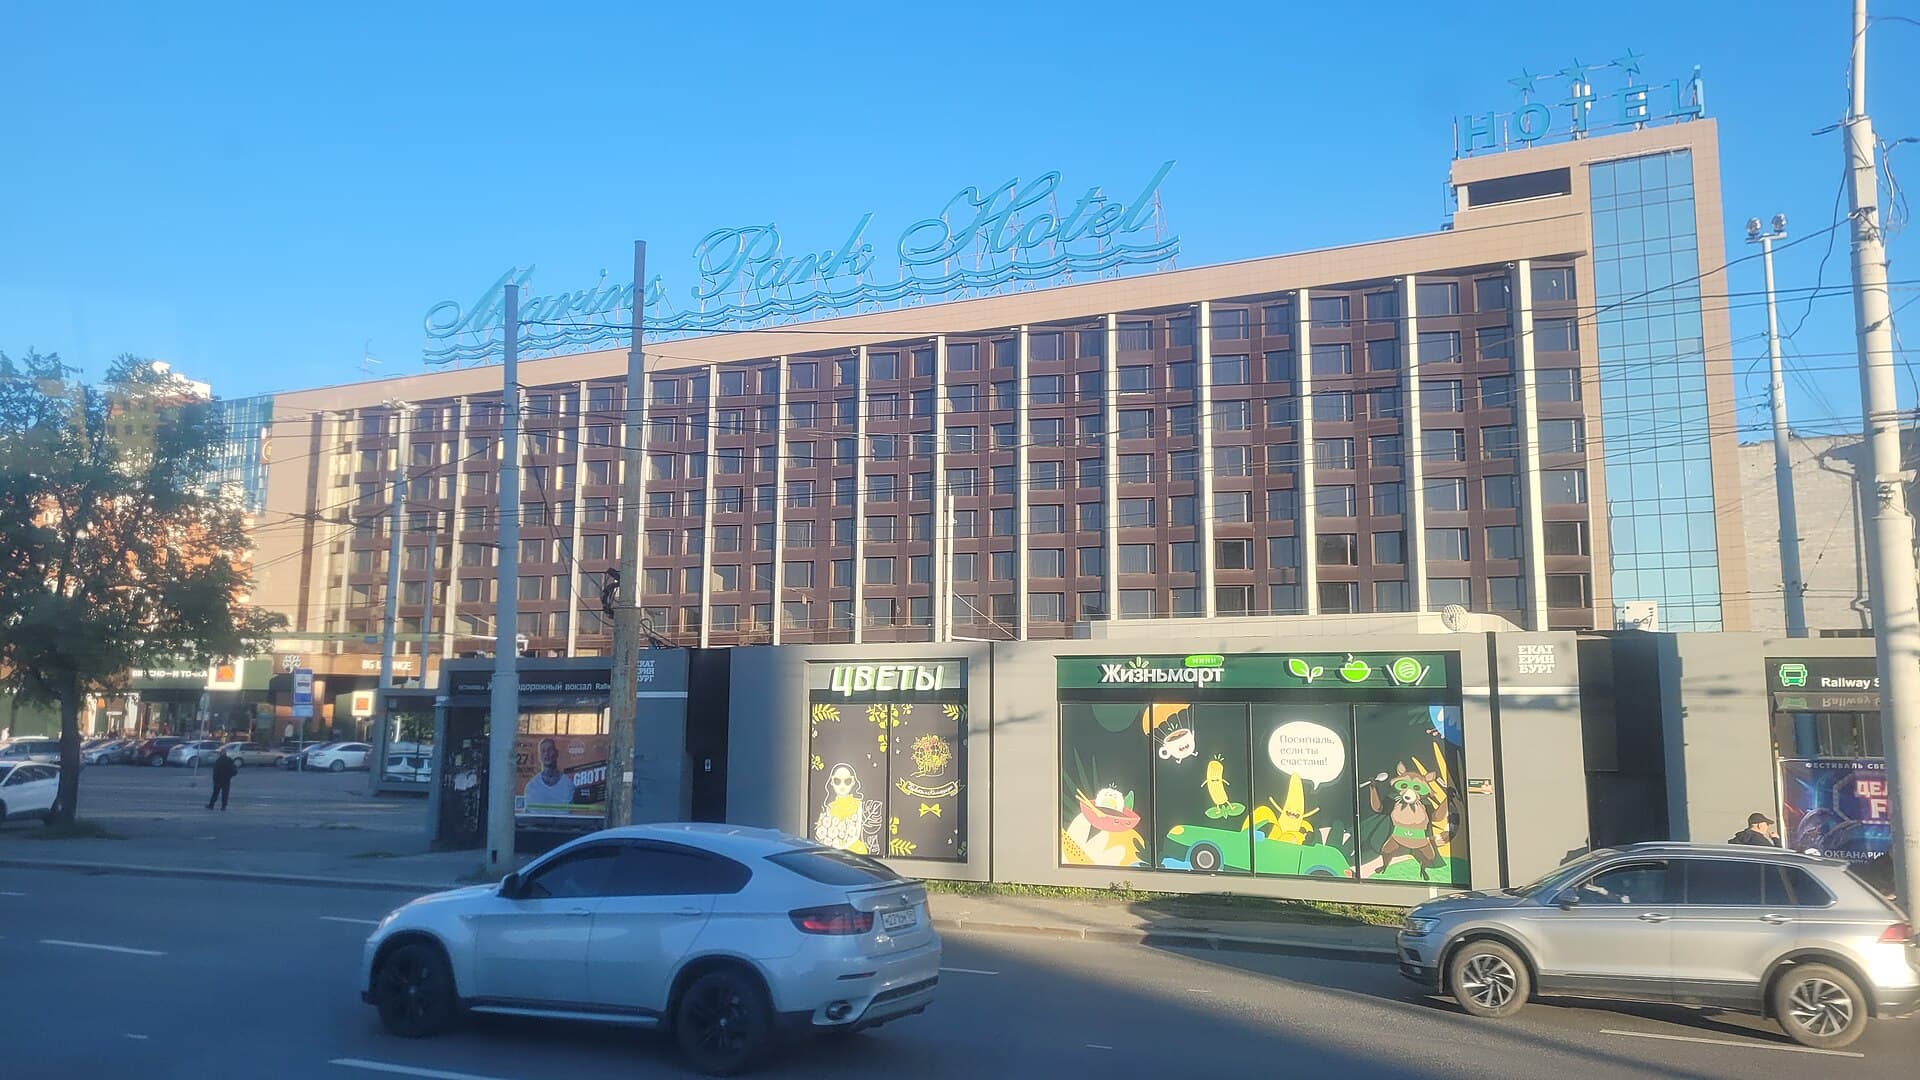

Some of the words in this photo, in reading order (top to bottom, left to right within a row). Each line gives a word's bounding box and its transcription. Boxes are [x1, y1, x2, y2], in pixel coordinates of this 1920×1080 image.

[1464, 79, 1701, 151] HOTEL
[424, 264, 666, 338] Marins
[692, 211, 875, 299] Park
[898, 160, 1177, 266] Hotel
[1518, 644, 1554, 654] ЕКАТ
[1519, 654, 1555, 664] ЕРИН
[376, 660, 412, 670] LNGE
[1519, 663, 1556, 674] БУРГ
[831, 665, 944, 697] ЦВЕТЫ
[1101, 663, 1225, 688] Жизньмарт
[1821, 677, 1870, 689] Railway
[1280, 735, 1335, 744] Посигналь,
[1280, 757, 1328, 766] счастлив!
[1824, 849, 1885, 860] ОКЕАНАРИ
